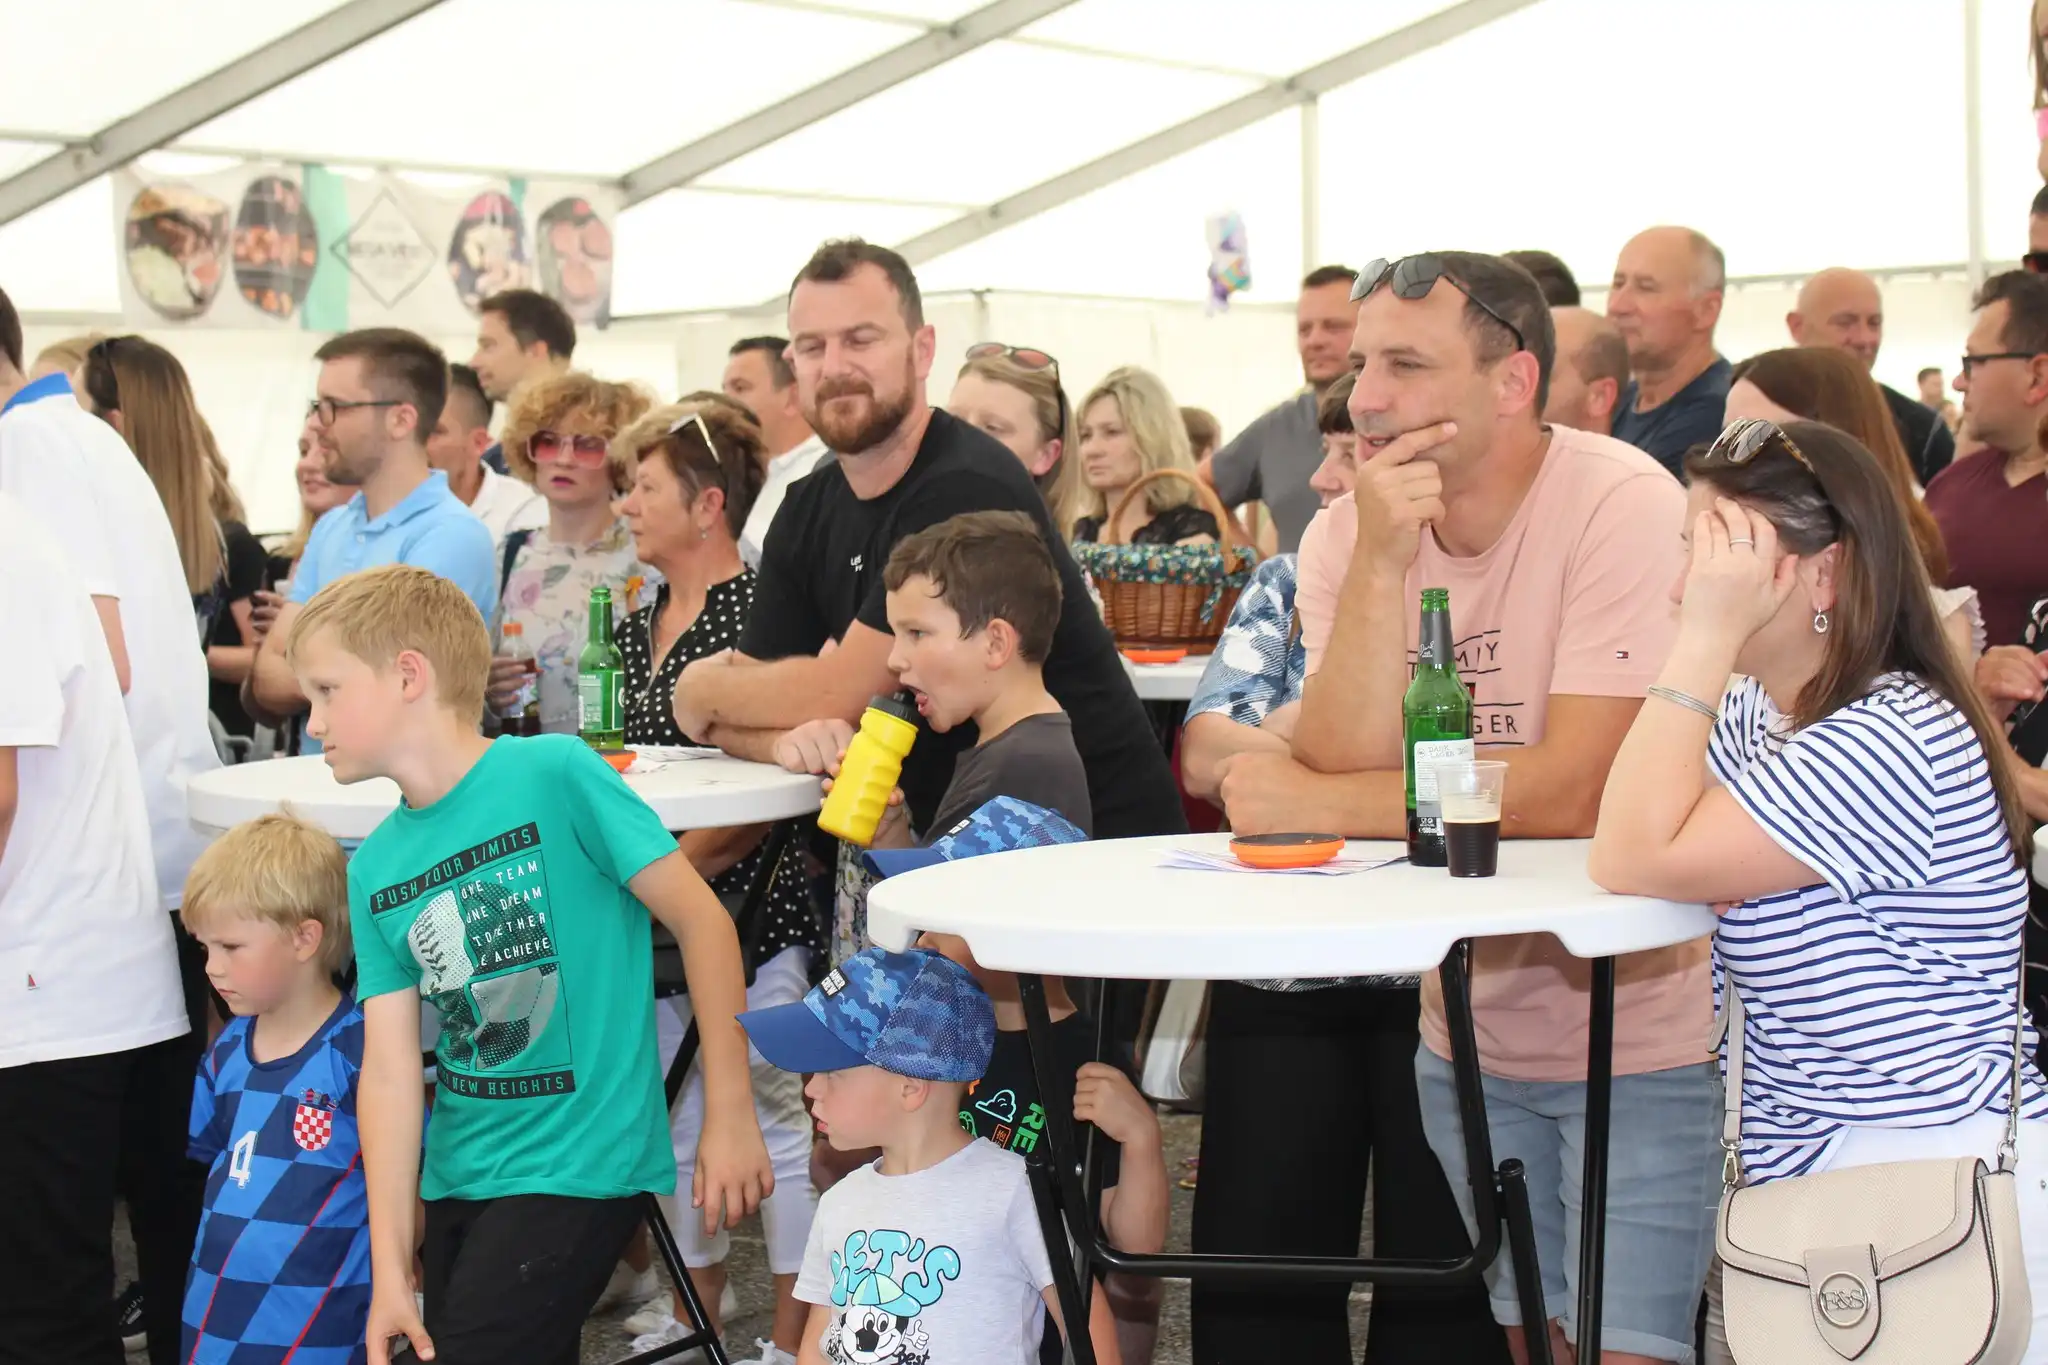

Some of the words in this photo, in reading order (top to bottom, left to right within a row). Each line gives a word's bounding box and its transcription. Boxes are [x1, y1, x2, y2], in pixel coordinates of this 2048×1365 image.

[376, 881, 418, 909] PUSH
[424, 858, 463, 887] YOUR
[471, 828, 532, 866] LIMITS
[461, 880, 484, 899] ONE
[496, 860, 538, 884] TEAM
[495, 937, 550, 963] ACHIEVE
[452, 1076, 478, 1094] NEW
[487, 1076, 564, 1096] HEIGHTS
[1010, 1102, 1045, 1153] RE
[229, 1130, 258, 1189] 4
[831, 1229, 961, 1307] LET'S
